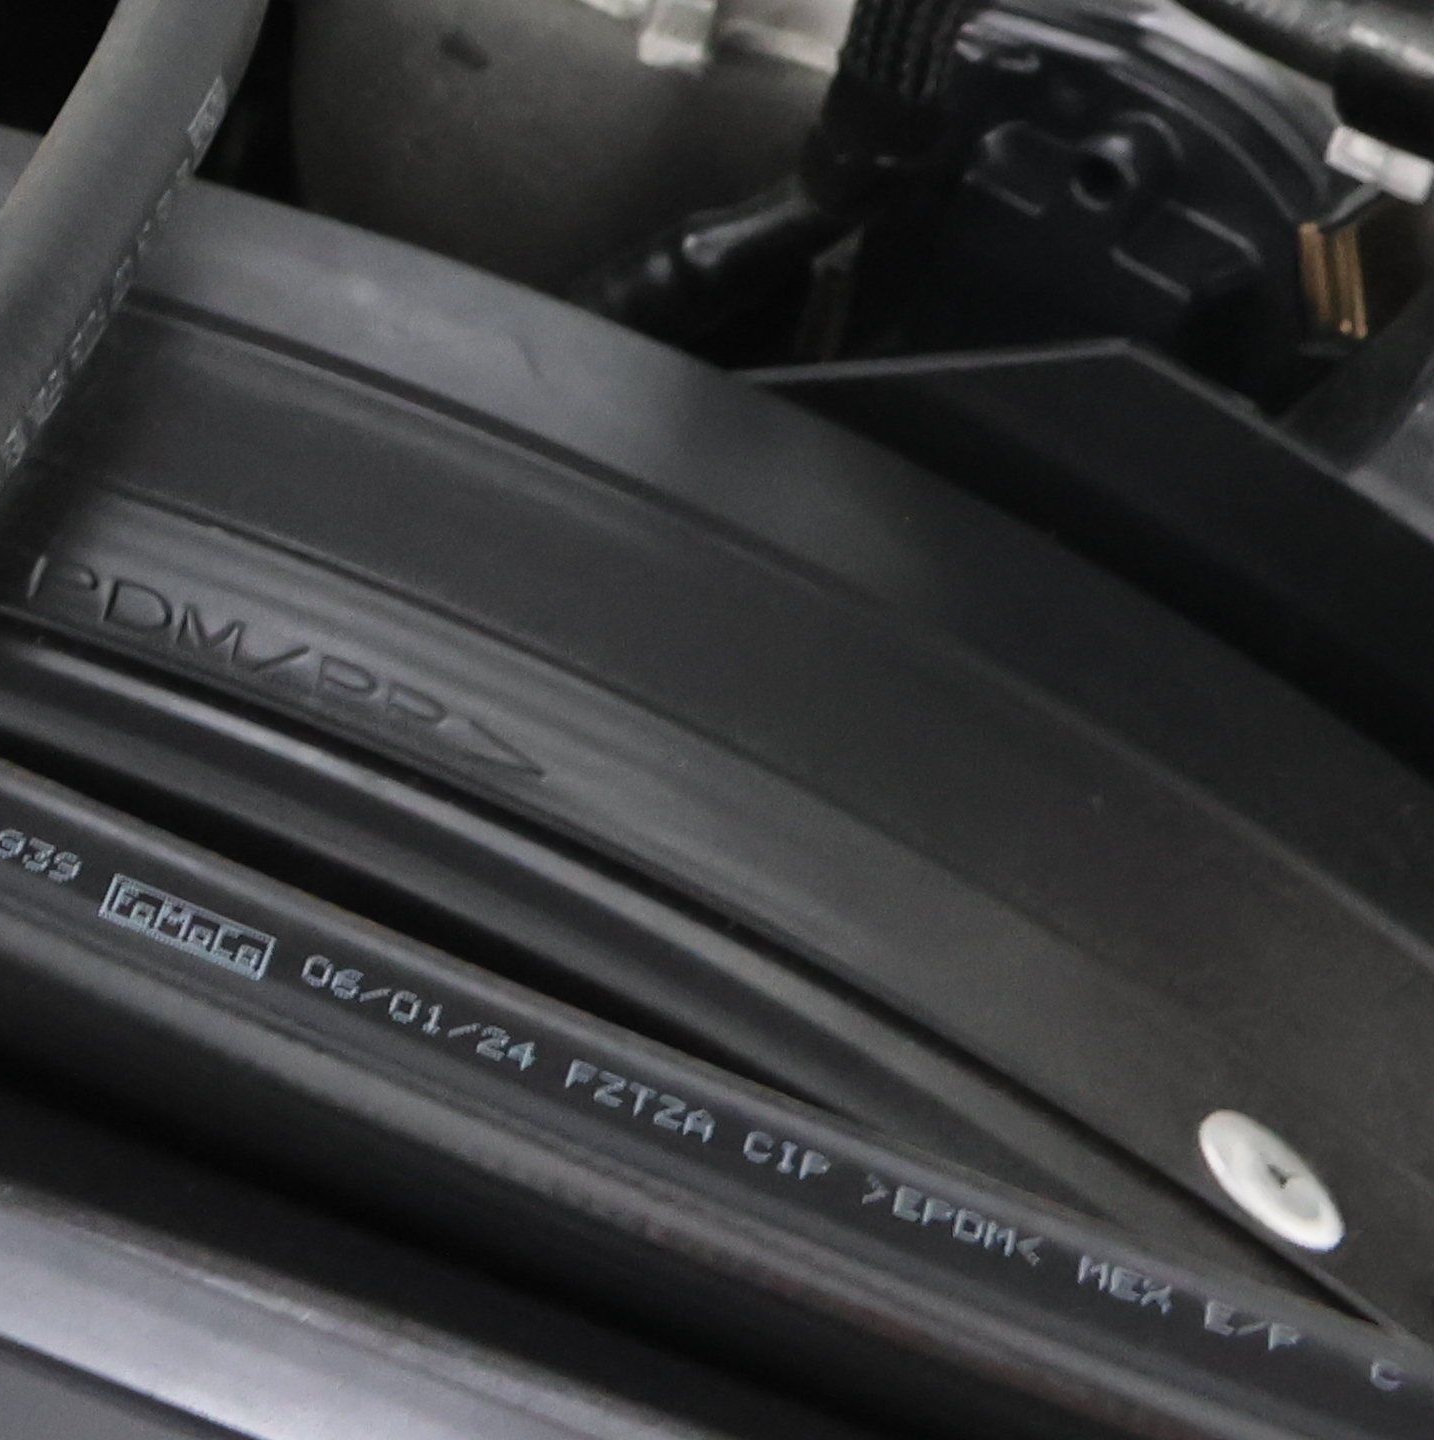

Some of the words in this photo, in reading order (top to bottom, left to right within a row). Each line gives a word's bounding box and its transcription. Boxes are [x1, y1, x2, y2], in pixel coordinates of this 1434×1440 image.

[301, 954, 537, 1071] 06/01/24
[743, 1130, 831, 1180] CIP
[1077, 1254, 1173, 1315] MEX
